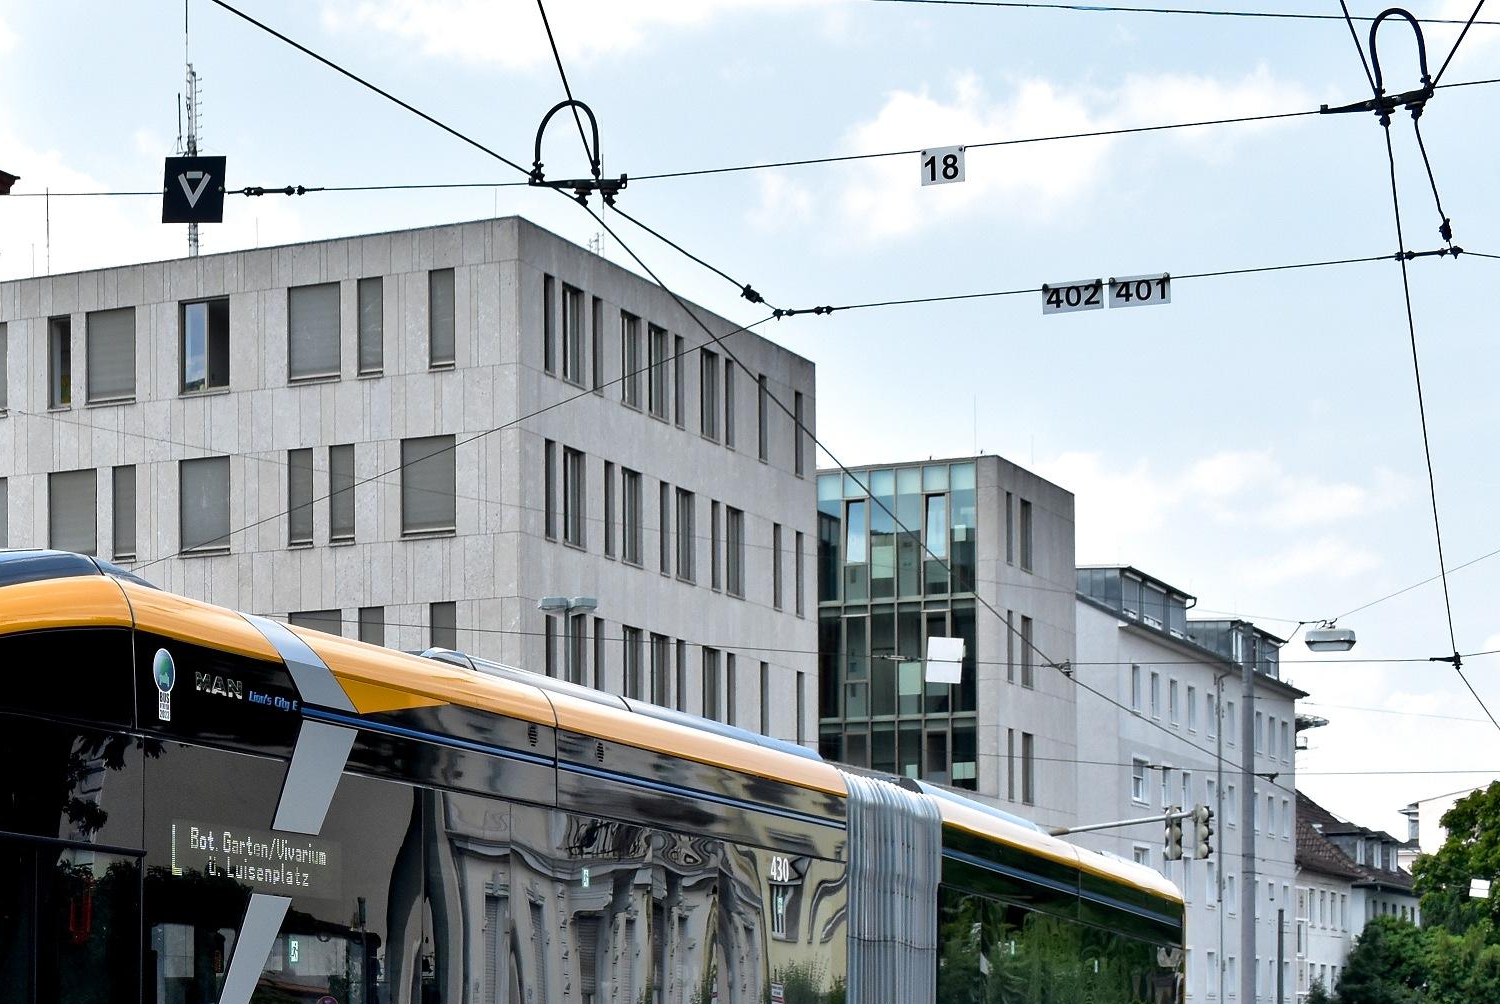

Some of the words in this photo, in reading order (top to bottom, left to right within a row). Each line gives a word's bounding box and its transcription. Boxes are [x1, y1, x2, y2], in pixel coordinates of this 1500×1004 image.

[924, 154, 959, 181] 18
[1046, 285, 1100, 309] 402
[1115, 279, 1168, 302] 401
[195, 671, 242, 699] MAN
[171, 824, 182, 876] L
[190, 827, 218, 852] Bot.
[222, 831, 326, 866] Garten/Vivarium
[227, 857, 309, 887] Luisenplatz
[770, 856, 789, 882] 430
